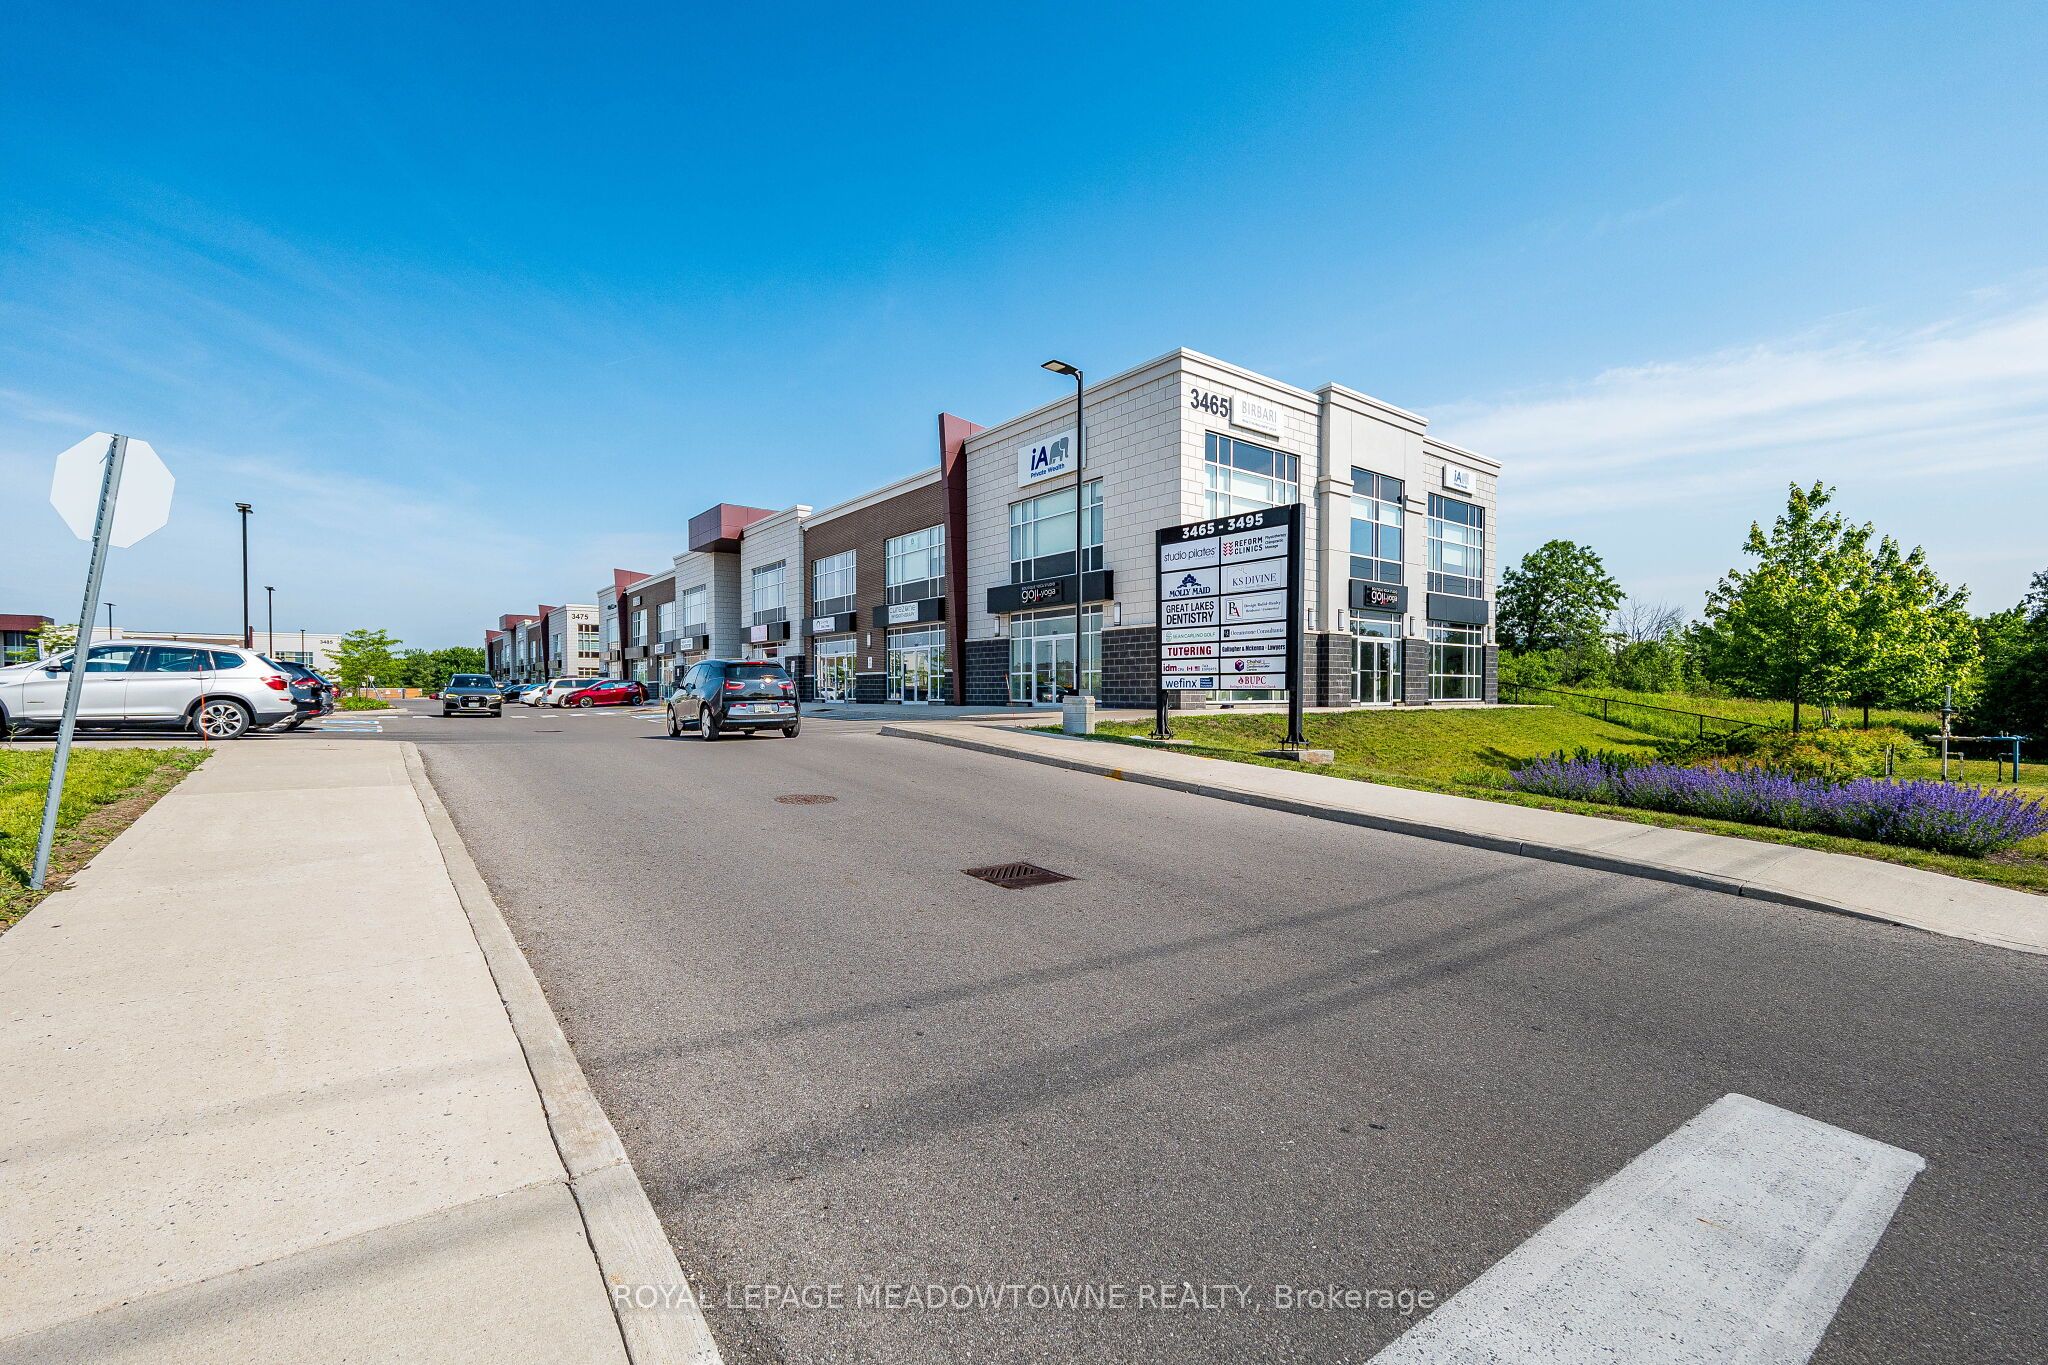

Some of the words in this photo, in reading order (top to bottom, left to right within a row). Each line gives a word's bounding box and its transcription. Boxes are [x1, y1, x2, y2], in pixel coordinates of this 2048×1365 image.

[1190, 388, 1229, 418] 3465
[1242, 401, 1277, 423] BIRBARI
[1030, 469, 1047, 479] Private
[1048, 463, 1065, 473] Wealth
[1182, 522, 1215, 539] 3465
[1227, 513, 1264, 531] 3495
[1234, 536, 1263, 548] REFORM
[1163, 550, 1187, 562] studio
[1188, 547, 1216, 560] pilates
[1234, 544, 1263, 555] CLINICS
[1232, 577, 1243, 587] KS
[1245, 573, 1277, 585] DIVINE
[1168, 588, 1191, 598] MOLLY
[1191, 586, 1211, 596] MAID
[1166, 603, 1189, 614] GREAT
[1190, 601, 1215, 612] LAKES
[1166, 610, 1214, 625] DENTISTRY
[1163, 663, 1178, 672] idm
[1165, 677, 1196, 688] wefinx
[1244, 675, 1267, 685] BUPC
